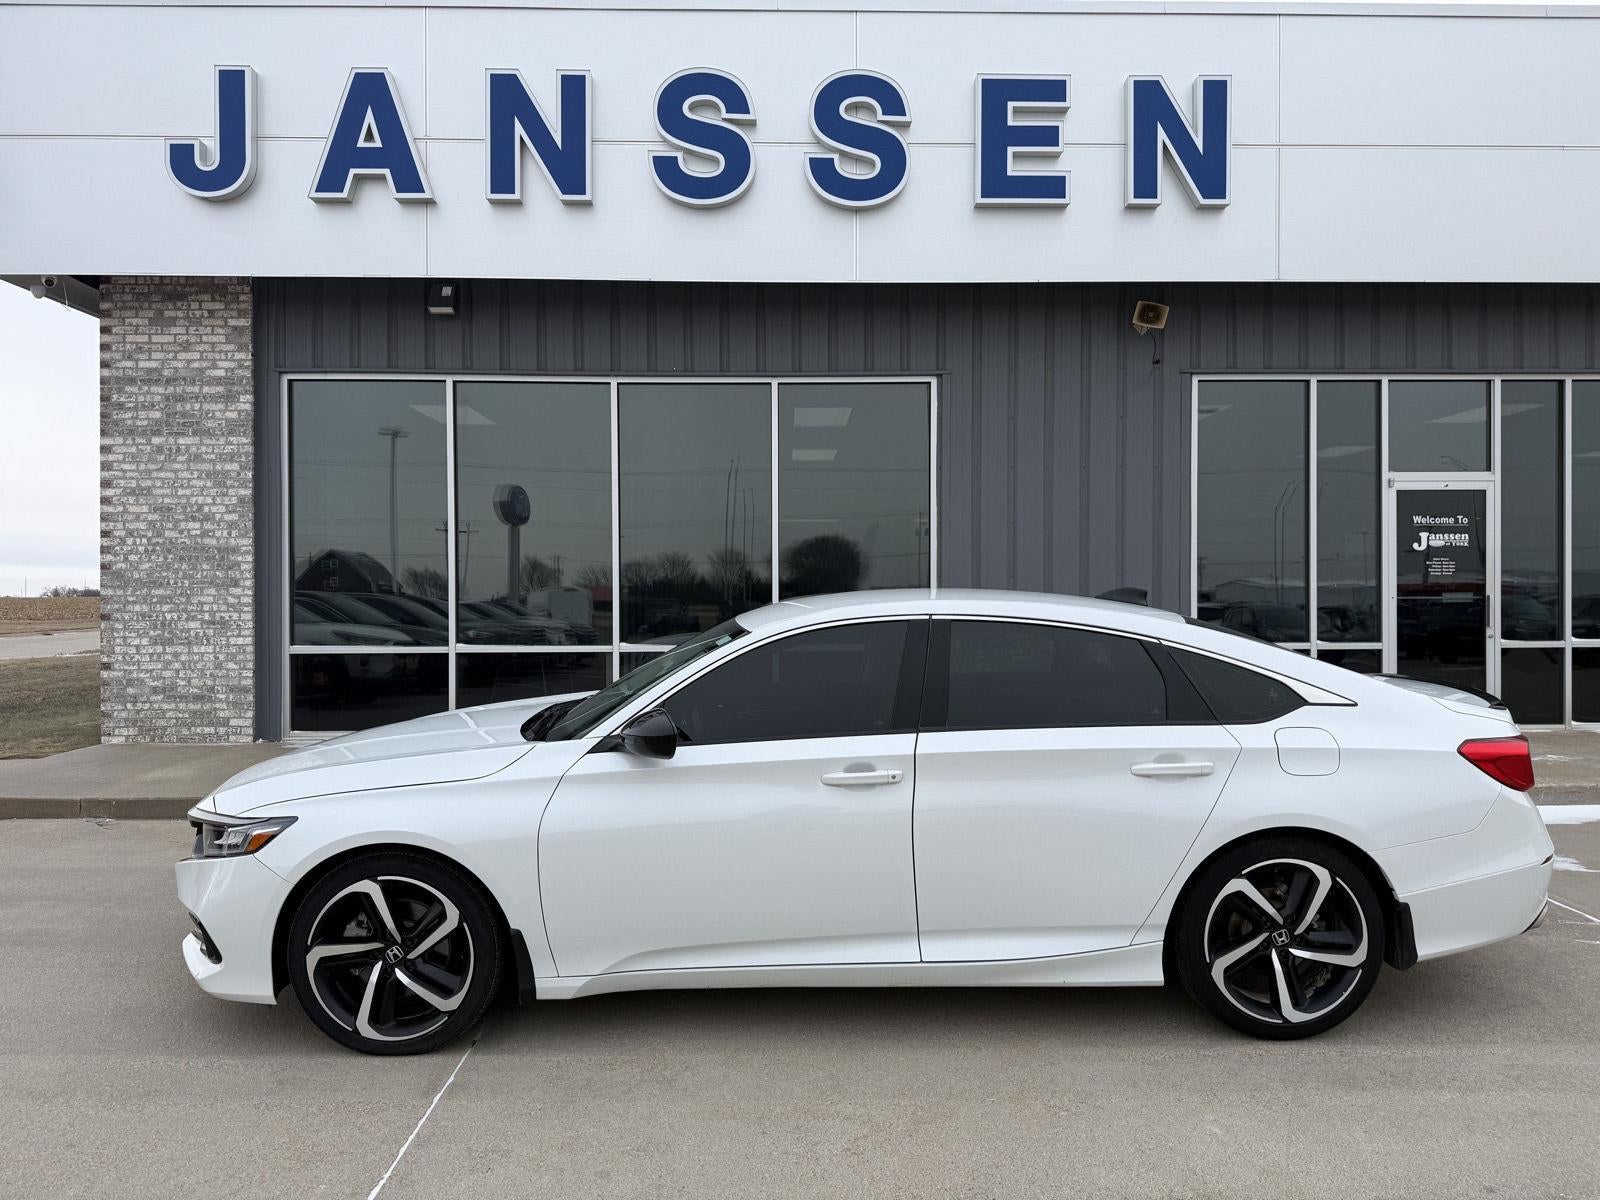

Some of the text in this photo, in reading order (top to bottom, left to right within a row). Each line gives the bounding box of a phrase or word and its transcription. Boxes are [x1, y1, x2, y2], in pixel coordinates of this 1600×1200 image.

[165, 65, 1232, 208] JANSSEN
[1413, 515, 1468, 524] Welcome To
[1412, 532, 1469, 551] Janssen
